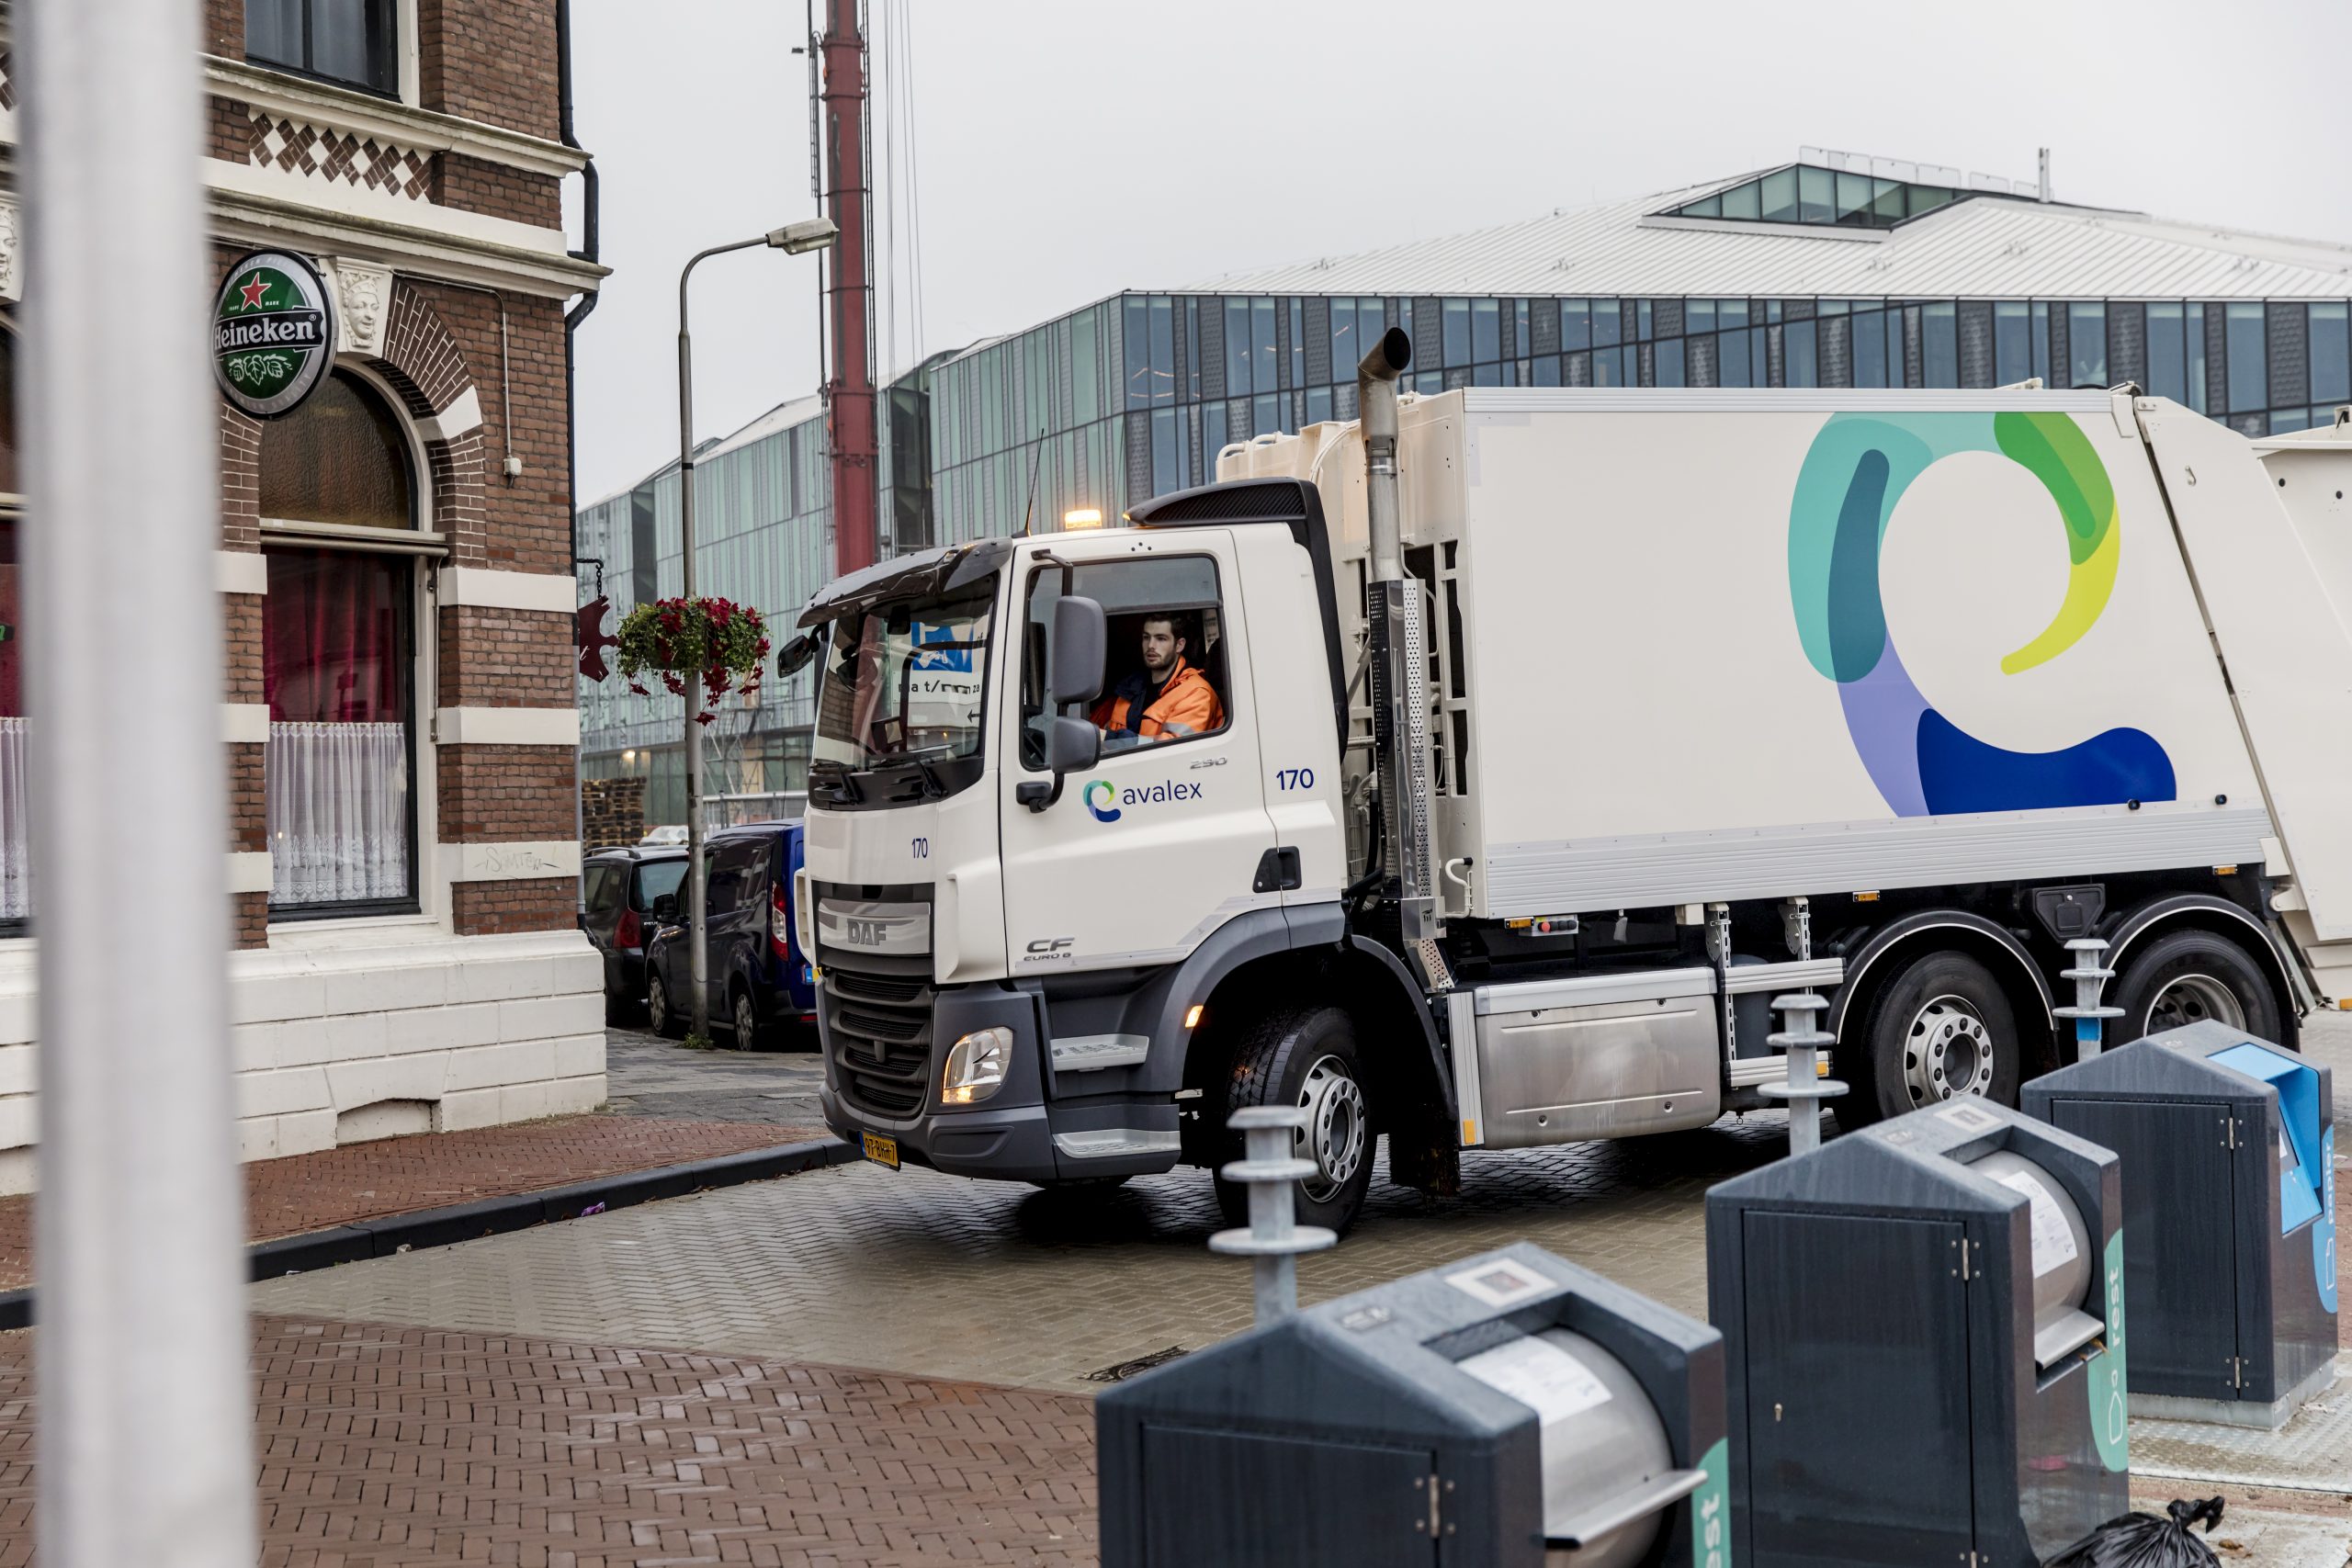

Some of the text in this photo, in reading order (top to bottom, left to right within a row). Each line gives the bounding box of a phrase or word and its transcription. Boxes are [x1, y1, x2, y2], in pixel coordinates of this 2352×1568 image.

[214, 317, 315, 350] Heineken
[1275, 768, 1315, 791] 170
[1123, 780, 1203, 806] avalex
[911, 837, 928, 859] 170
[847, 919, 887, 946] DAF
[1026, 937, 1075, 953] CF
[1023, 953, 1060, 962] EURO
[2109, 1267, 2120, 1348] rest
